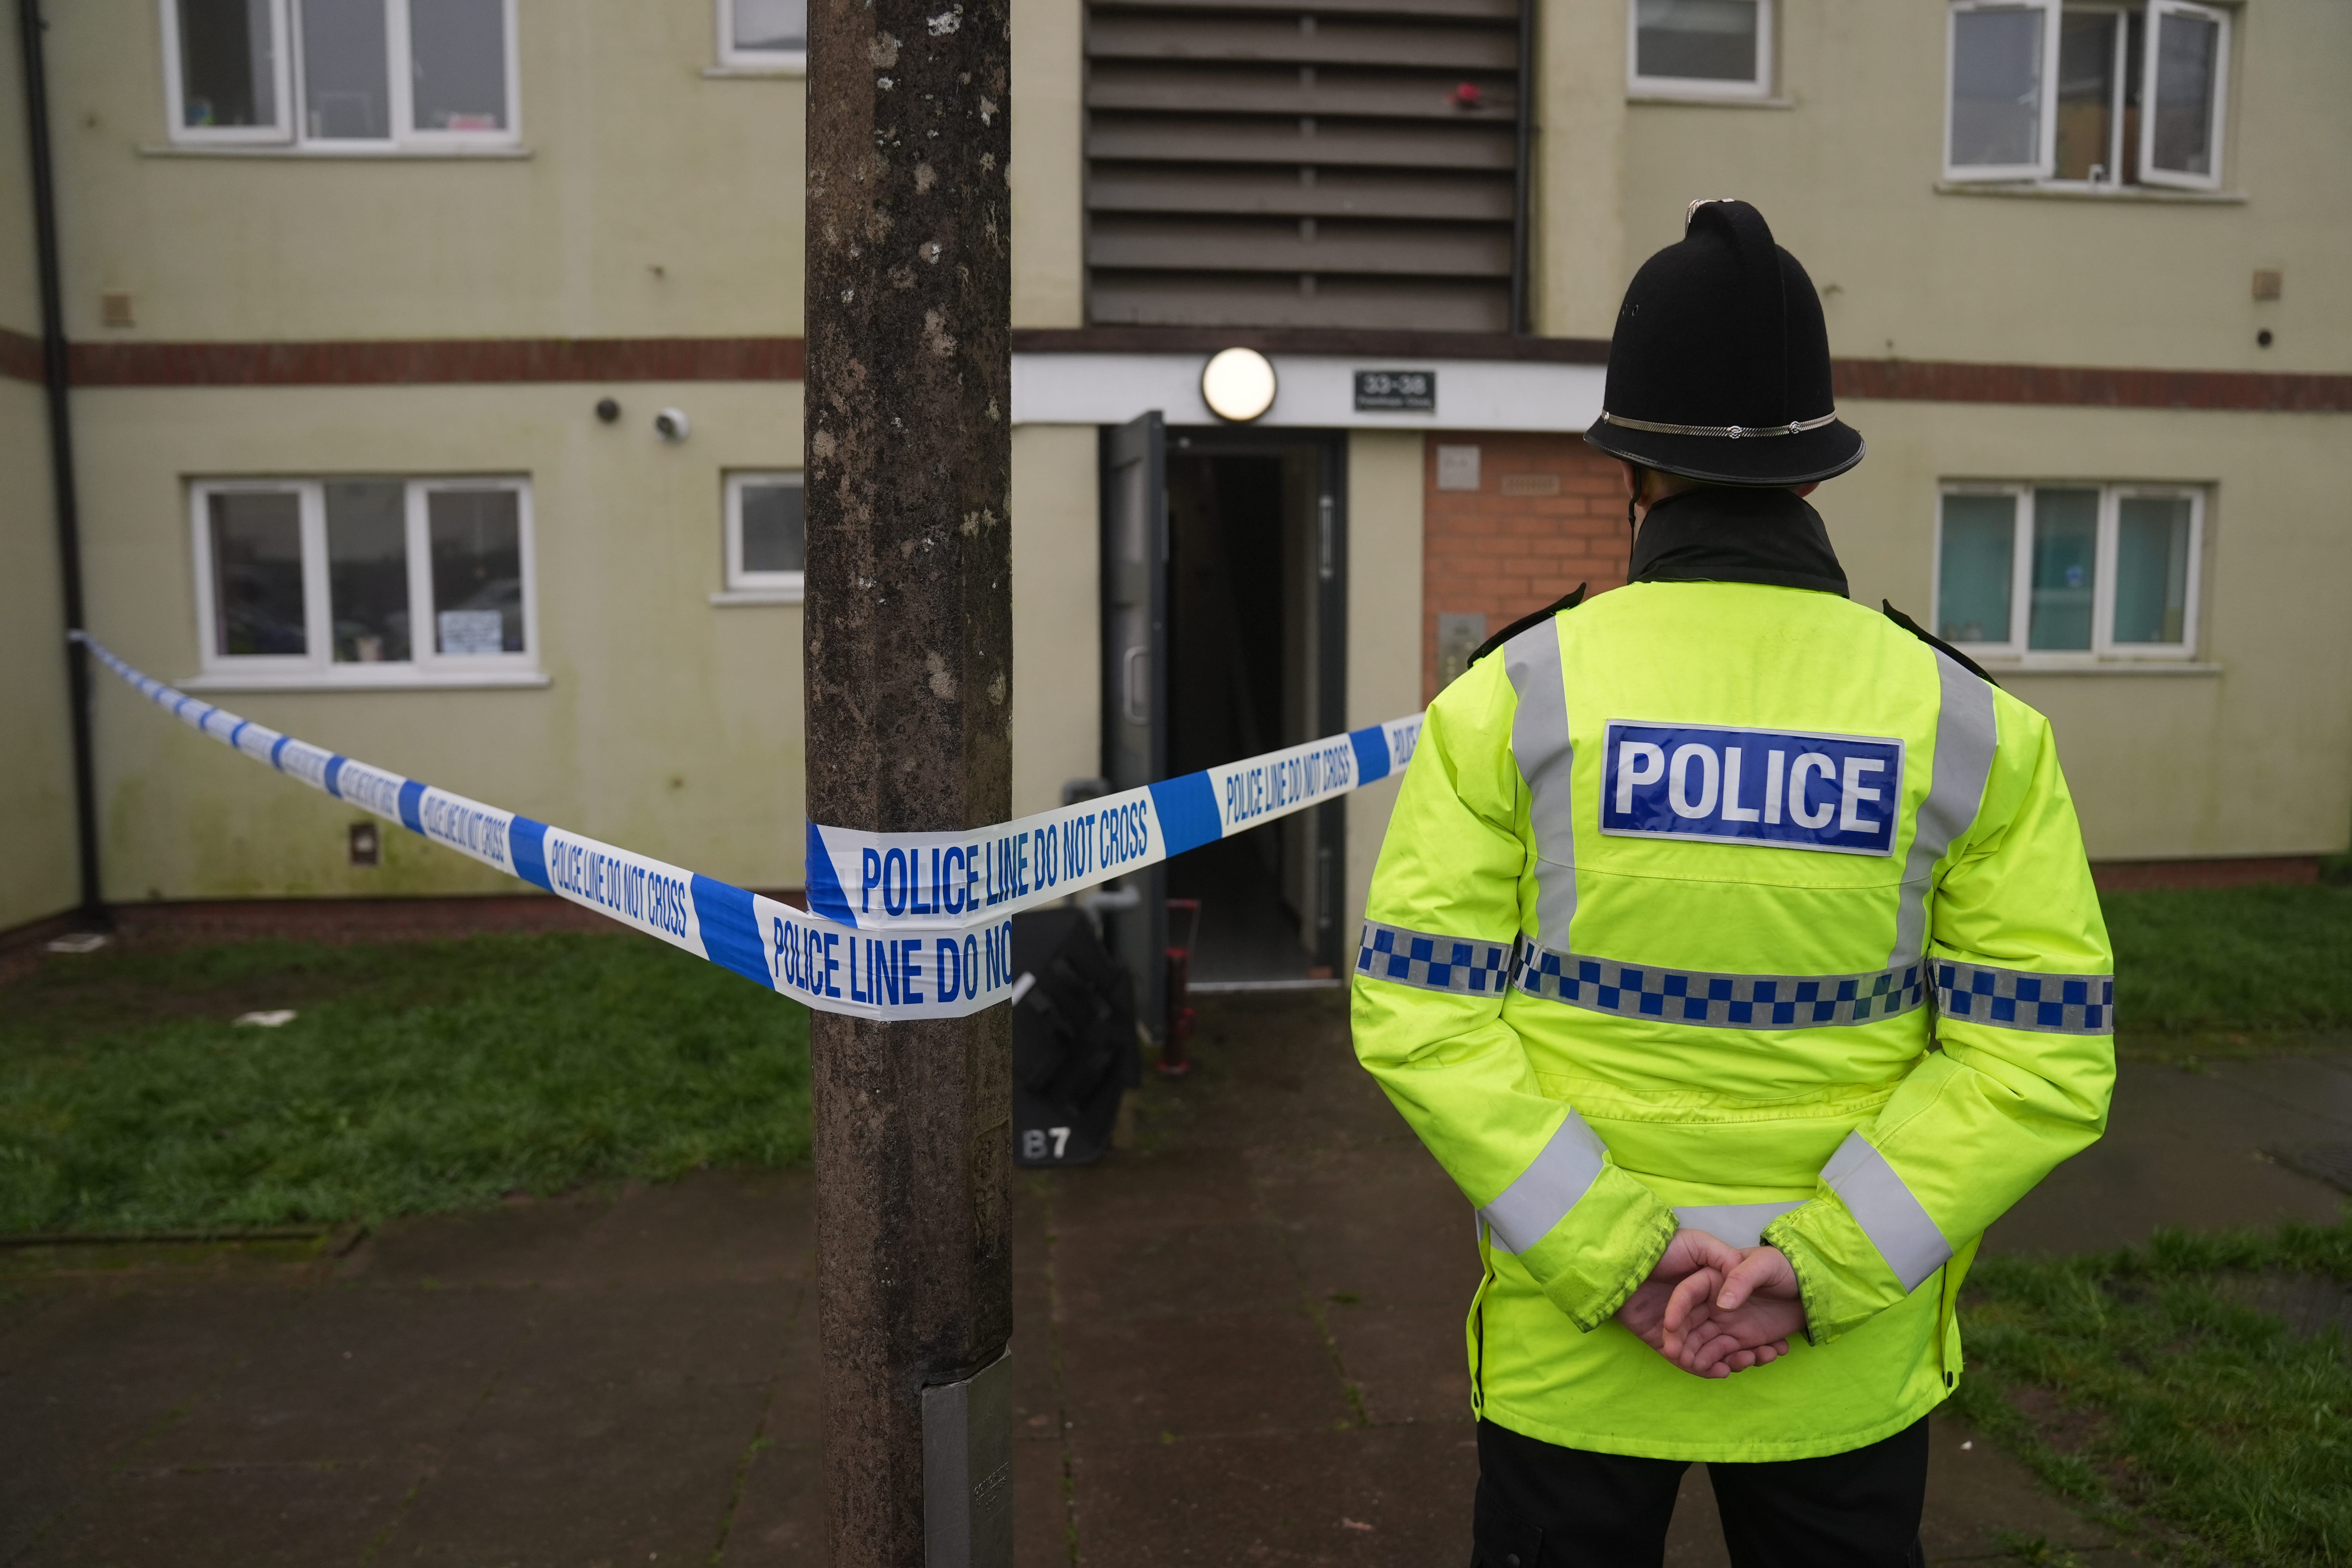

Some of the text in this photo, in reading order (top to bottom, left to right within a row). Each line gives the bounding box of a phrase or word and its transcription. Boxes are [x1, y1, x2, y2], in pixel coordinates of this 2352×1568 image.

[1227, 743, 1350, 826] POLICE LINE DO NOT CROSS
[1615, 740, 1885, 833] POLICE
[552, 839, 687, 938] POLICE LINE DO NOT CROSS
[862, 799, 1147, 916] POLICE LINE DO NOT CROSS
[774, 916, 841, 998] POLICE
[849, 936, 924, 1005] LINE
[936, 934, 978, 1003] DO
[1022, 1127, 1071, 1159] B7
